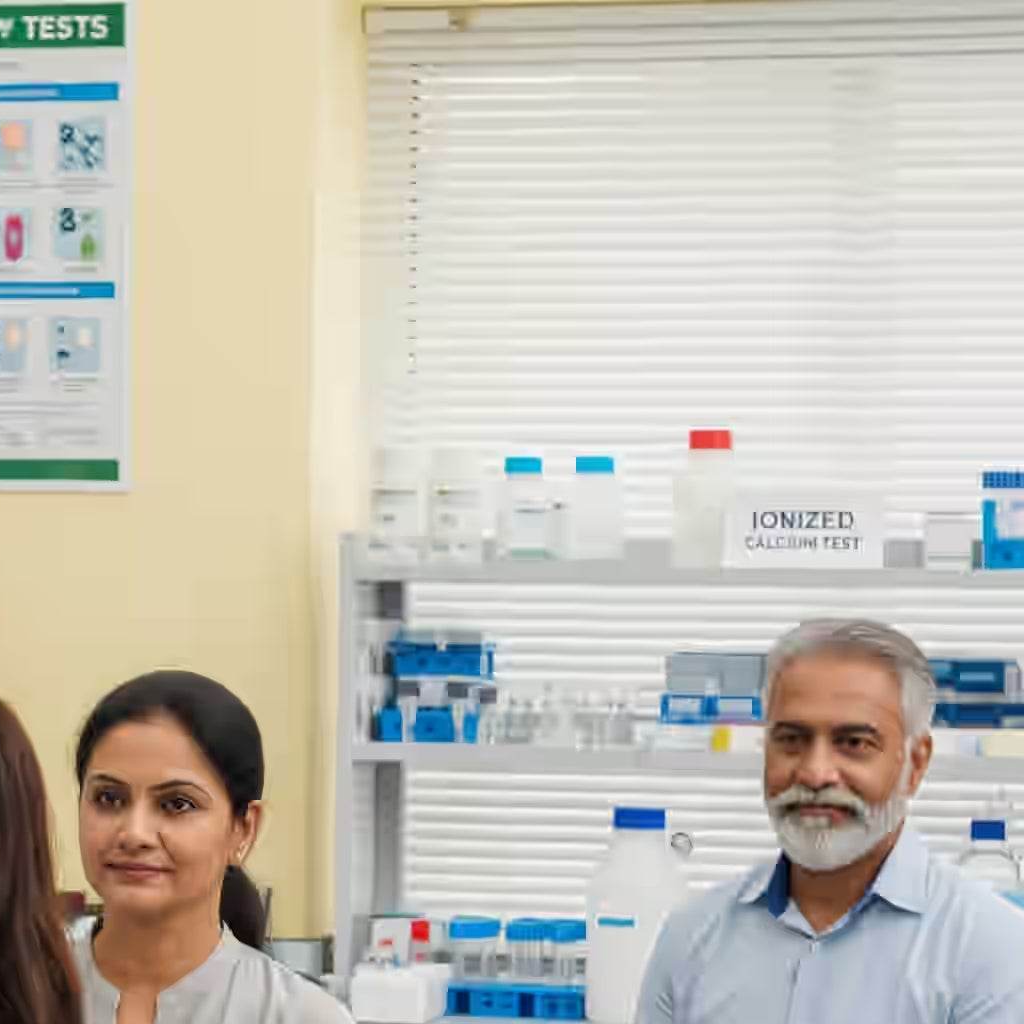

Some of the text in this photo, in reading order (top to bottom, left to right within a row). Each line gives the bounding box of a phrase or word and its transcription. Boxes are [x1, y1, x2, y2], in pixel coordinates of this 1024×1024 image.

[22, 14, 108, 40] TESTS
[752, 511, 854, 529] IONIZED
[823, 535, 862, 550] TEST
